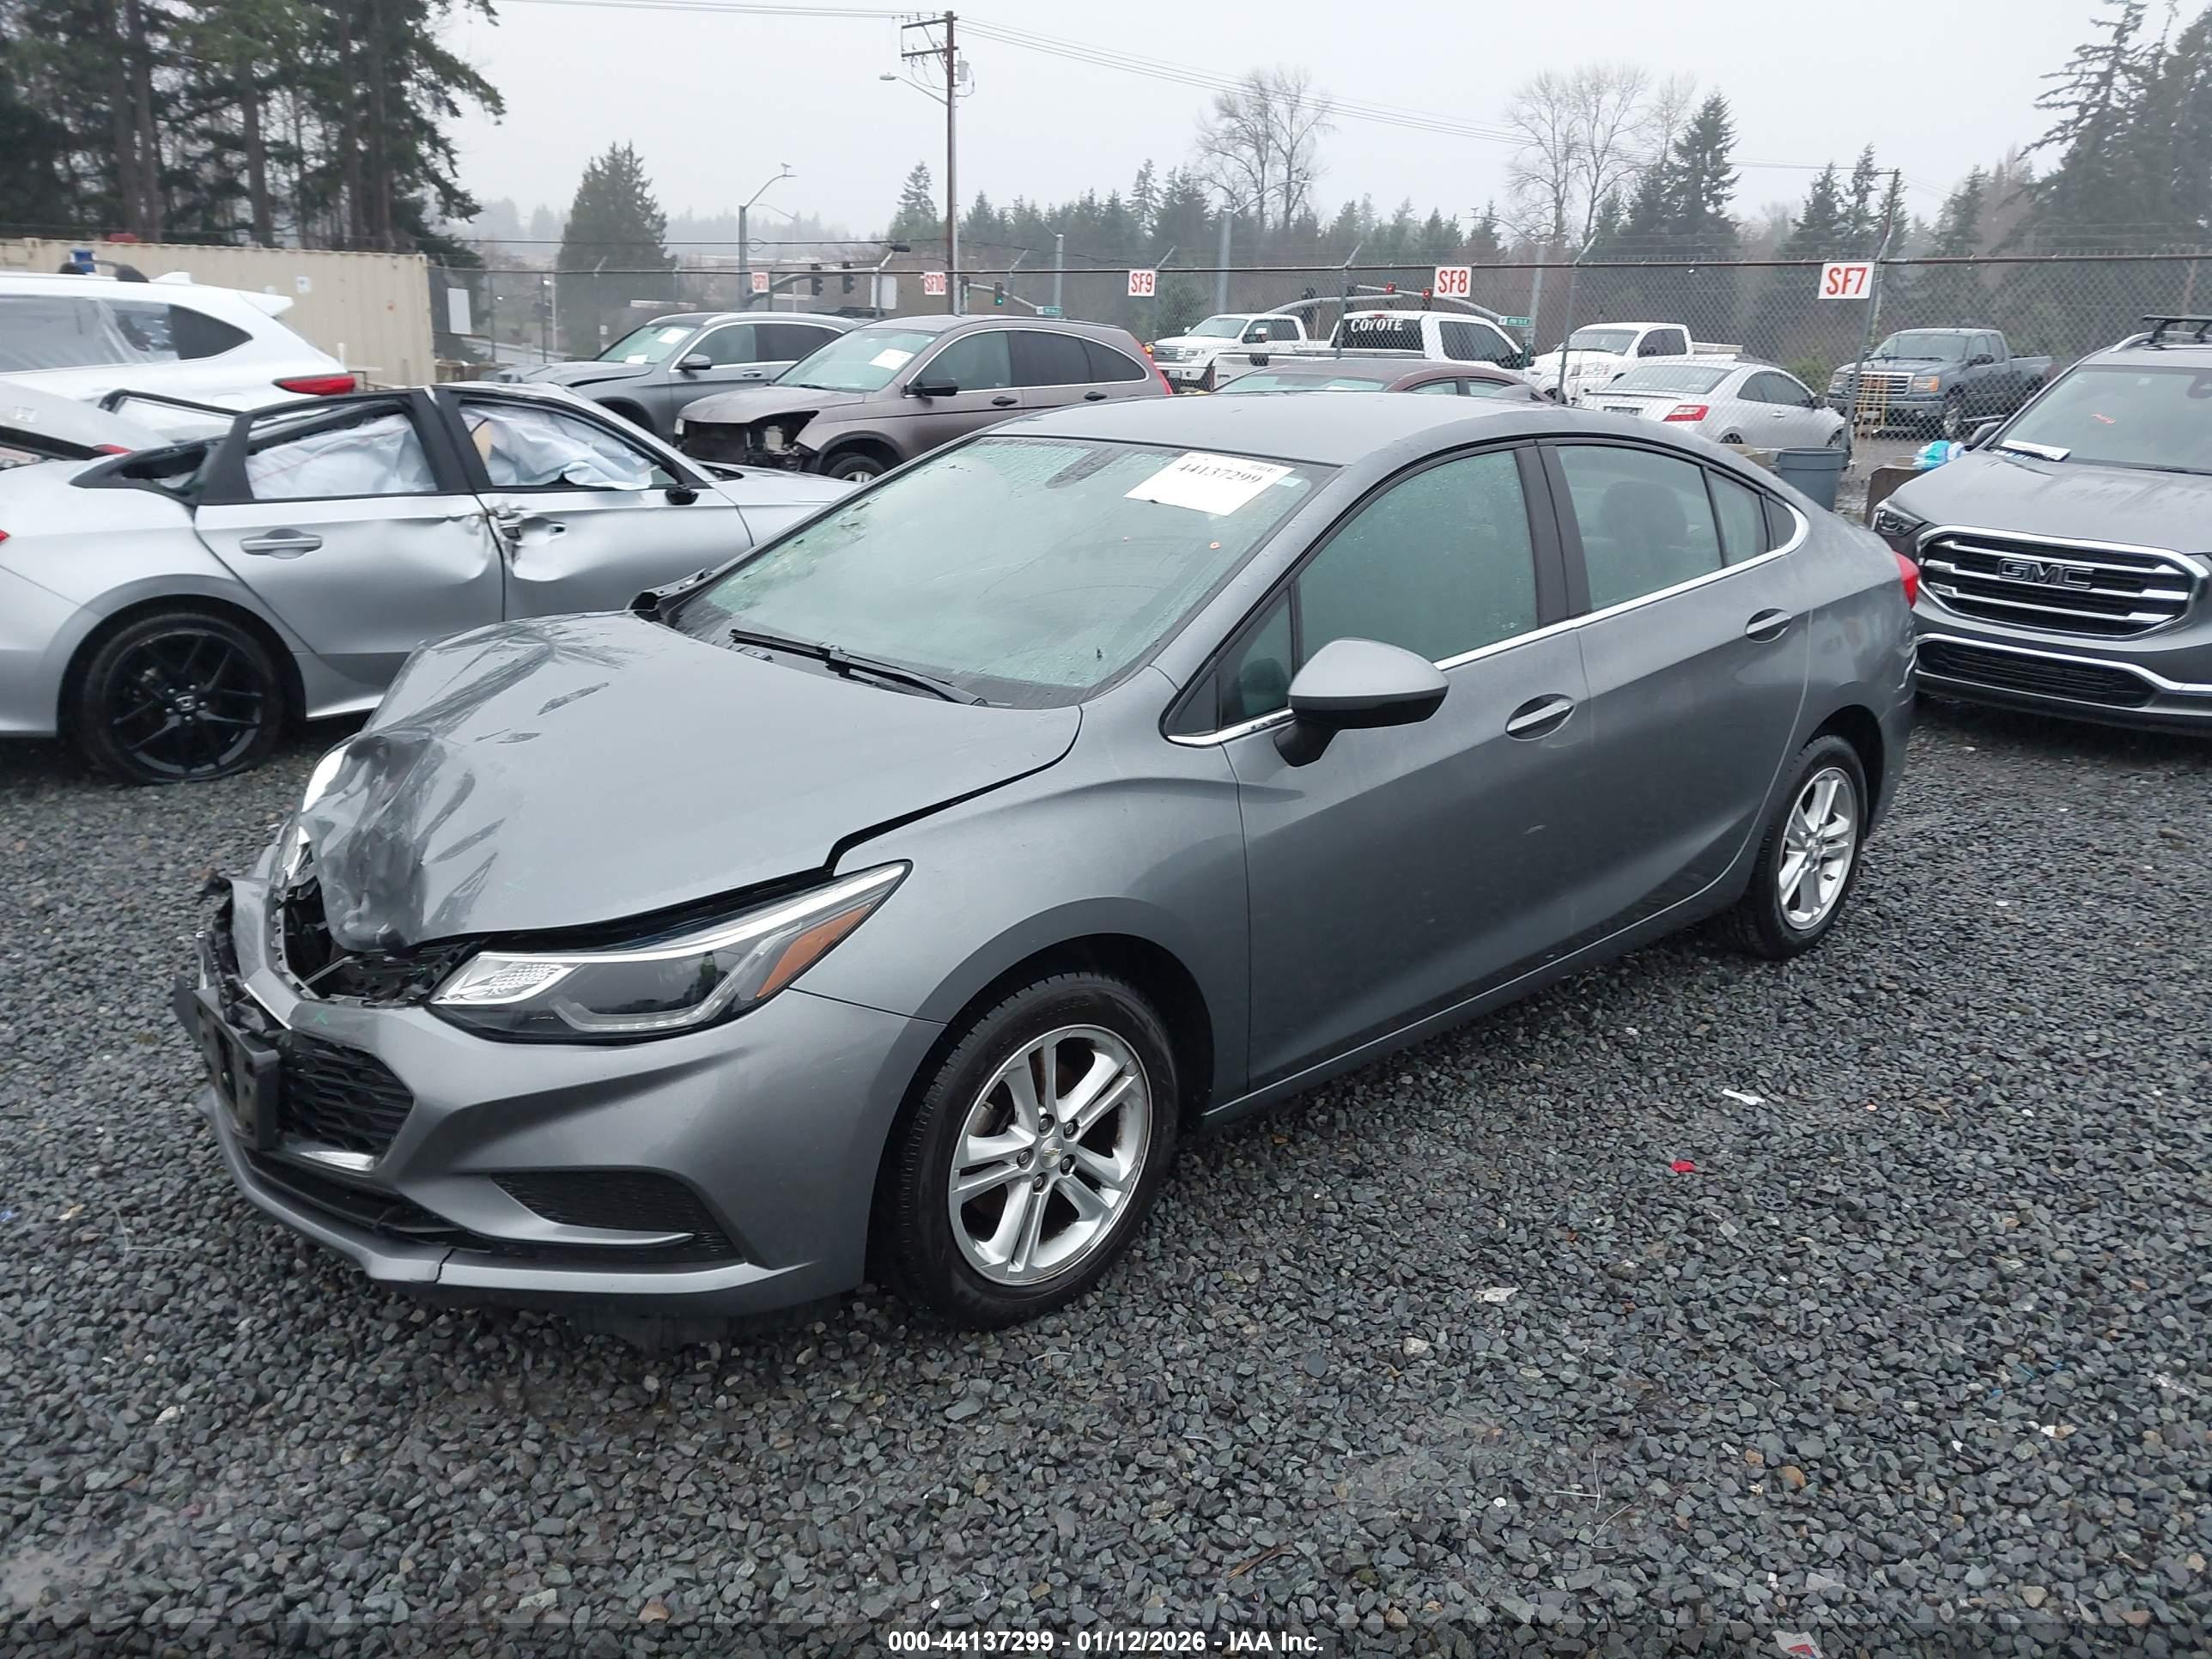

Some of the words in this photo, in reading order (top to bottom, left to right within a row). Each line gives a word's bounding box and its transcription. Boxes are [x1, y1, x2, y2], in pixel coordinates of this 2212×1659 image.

[1131, 273, 1152, 293] SF9
[1438, 270, 1467, 293] SF8
[1826, 267, 1867, 295] SF7
[1351, 319, 1403, 332] COYOTE
[1177, 464, 1263, 483] 44137299
[1997, 558, 2094, 589] GMC
